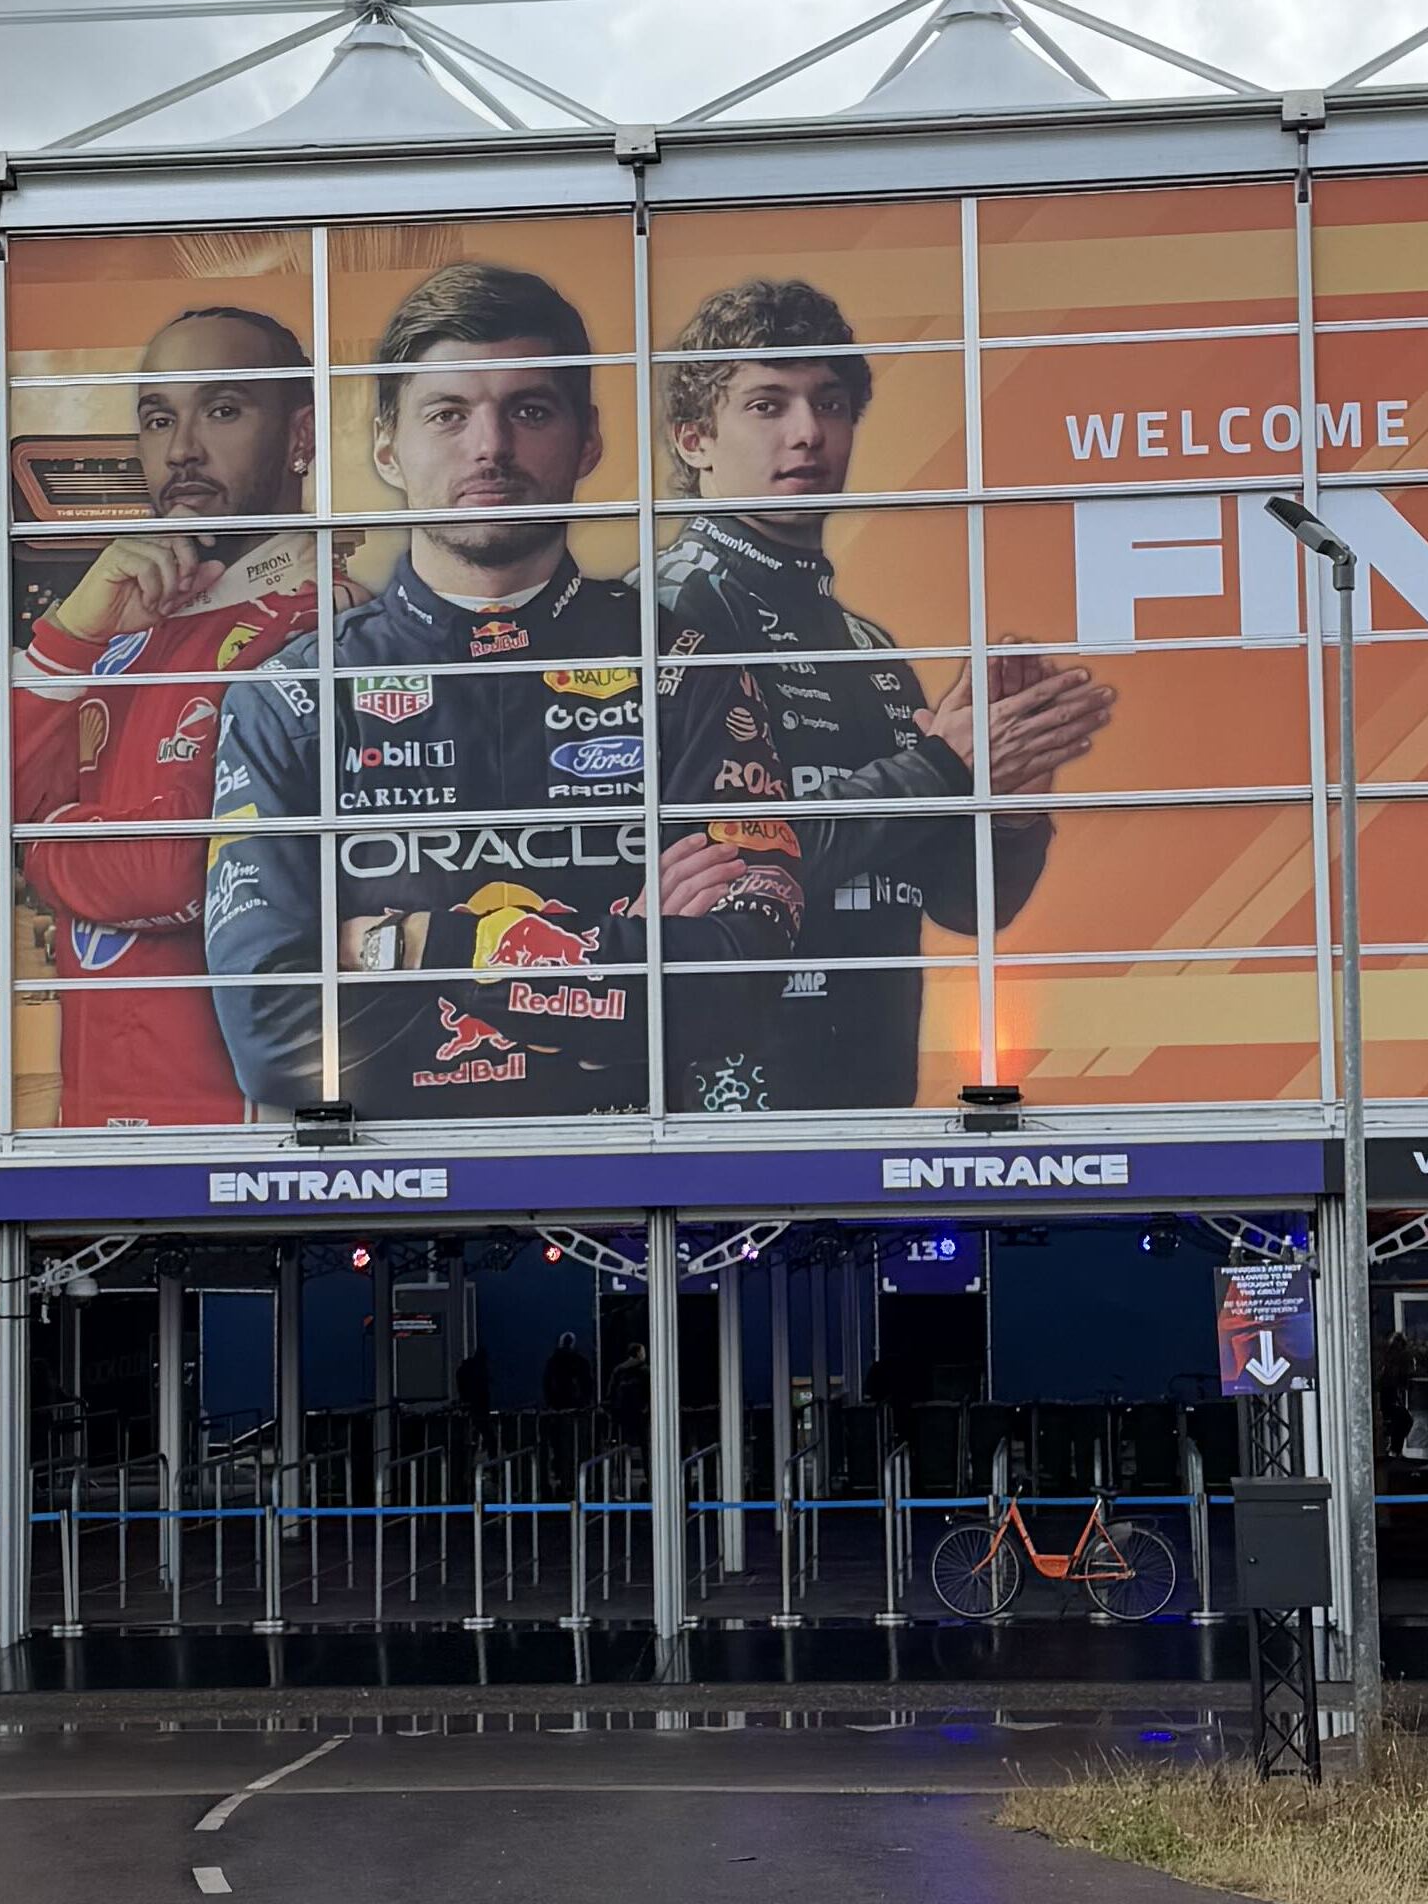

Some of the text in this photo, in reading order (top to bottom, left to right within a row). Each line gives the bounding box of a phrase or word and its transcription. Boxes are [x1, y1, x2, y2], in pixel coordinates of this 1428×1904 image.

[1066, 400, 1408, 459] WELCOME
[704, 522, 783, 571] TeamViewer
[246, 552, 292, 578] PERONI
[360, 675, 425, 690] TAG
[359, 693, 429, 718] HEUER
[345, 742, 420, 773] Mobil
[573, 743, 640, 771] Ford
[340, 787, 456, 809] CARLYLE
[340, 823, 647, 879] ORACLE
[509, 982, 626, 1020] Red Bull
[413, 1053, 526, 1087] Red Bull
[209, 1167, 447, 1202] ENTRANCE
[882, 1154, 1129, 1189] ENTRANCE
